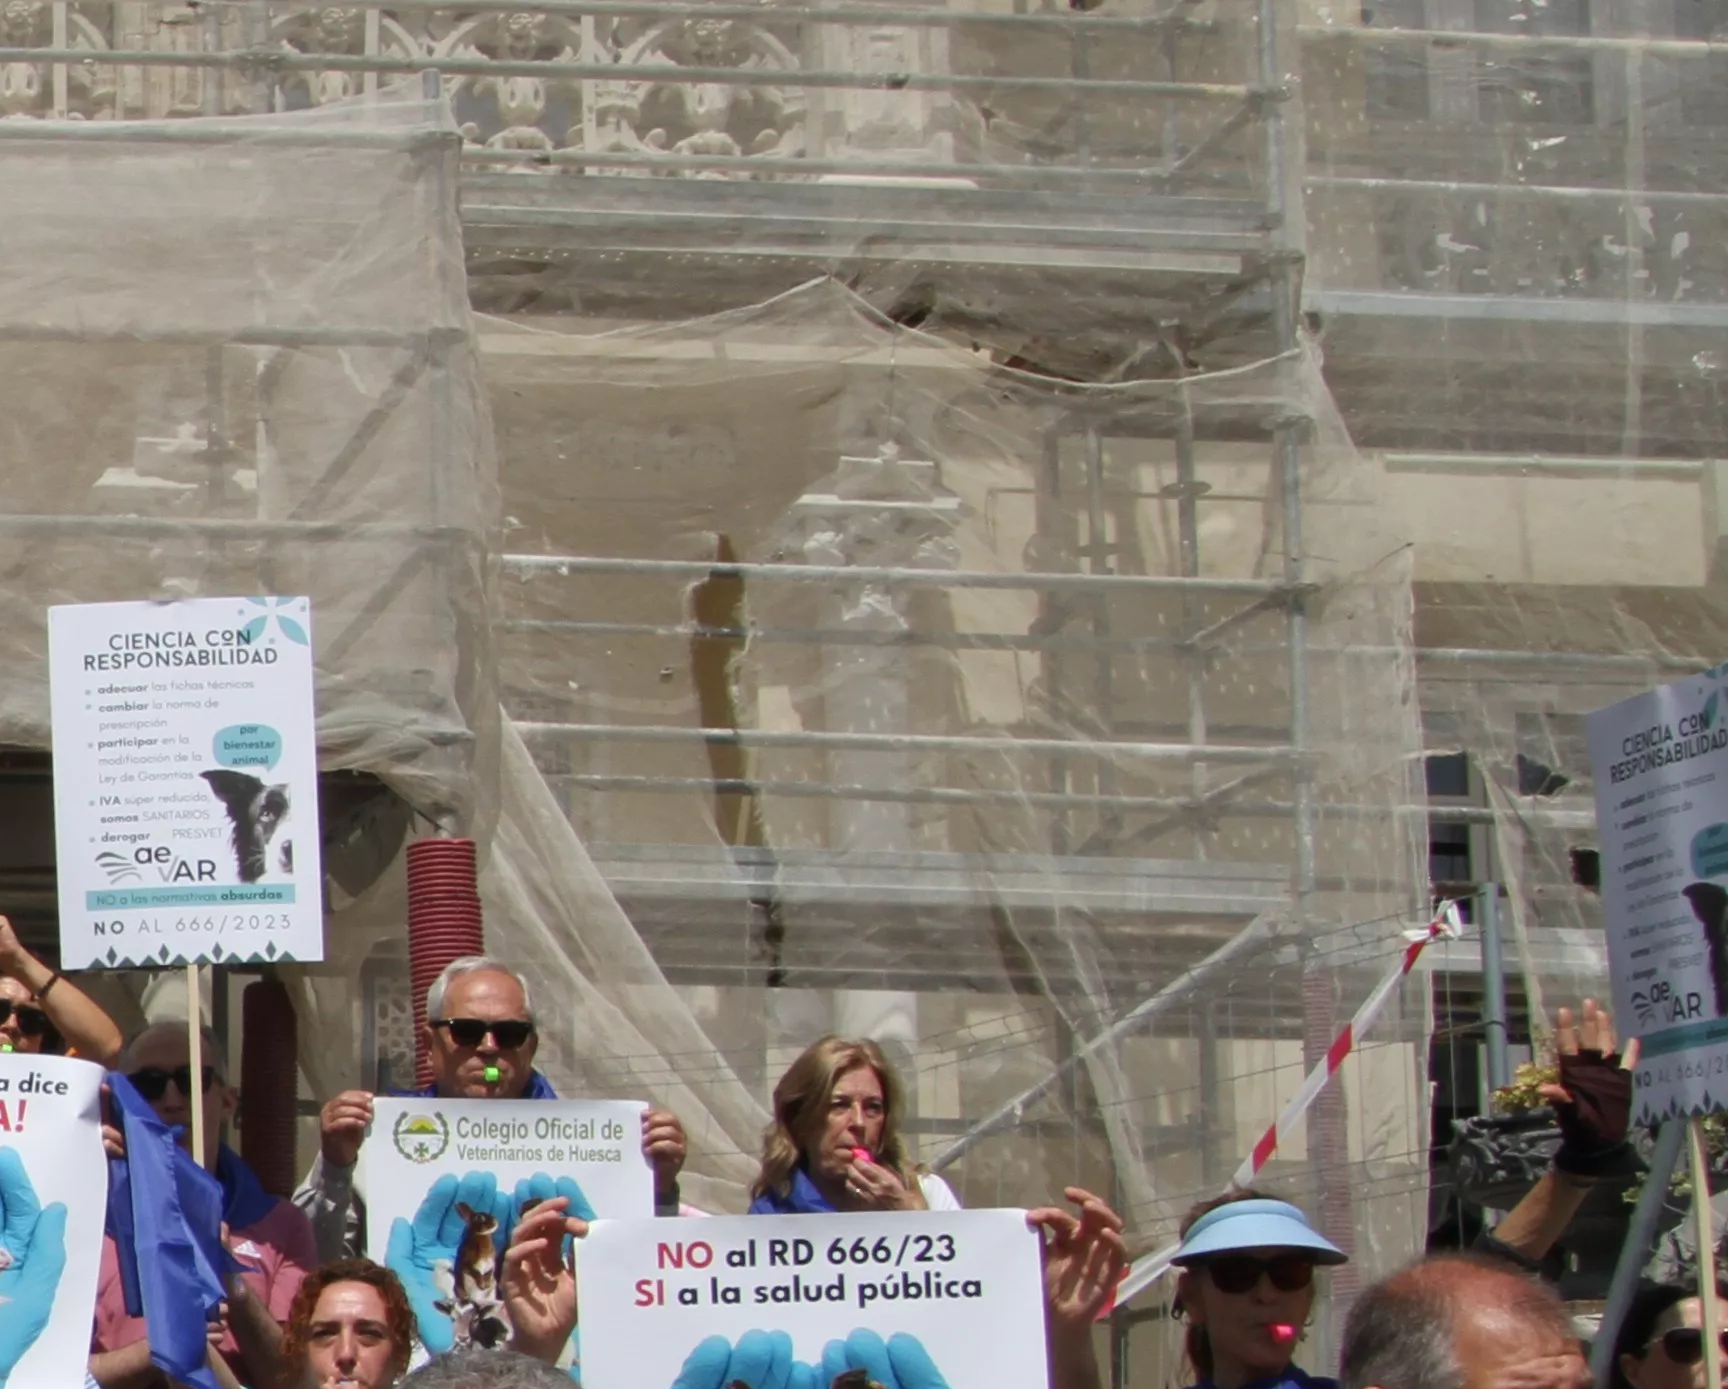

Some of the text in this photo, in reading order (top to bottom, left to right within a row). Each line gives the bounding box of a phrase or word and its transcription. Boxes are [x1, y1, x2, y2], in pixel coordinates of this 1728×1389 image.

[109, 631, 197, 651] CIENCIA
[83, 649, 278, 671] RESPONSABILIDAD
[98, 682, 149, 694] adecuar
[98, 699, 150, 712] cambiar
[240, 724, 258, 736] por
[97, 736, 158, 751] participar
[223, 739, 276, 751] bienestar
[1623, 725, 1673, 756] CIENCIA
[232, 754, 269, 765] animal
[1610, 729, 1727, 784] RESPONSABILIDAD
[100, 796, 122, 806] IVA
[100, 813, 139, 824] somos
[101, 831, 150, 845] derogar
[221, 888, 283, 901] absurdas
[93, 914, 292, 935] NO AL 666/2023
[18, 1074, 68, 1095] dice
[457, 1117, 622, 1144] Colegio Oficial de
[457, 1145, 621, 1162] Veterinarios de Huesca
[657, 1234, 957, 1269] NO al RD 666/23
[634, 1271, 982, 1308] SI a la salud pública
